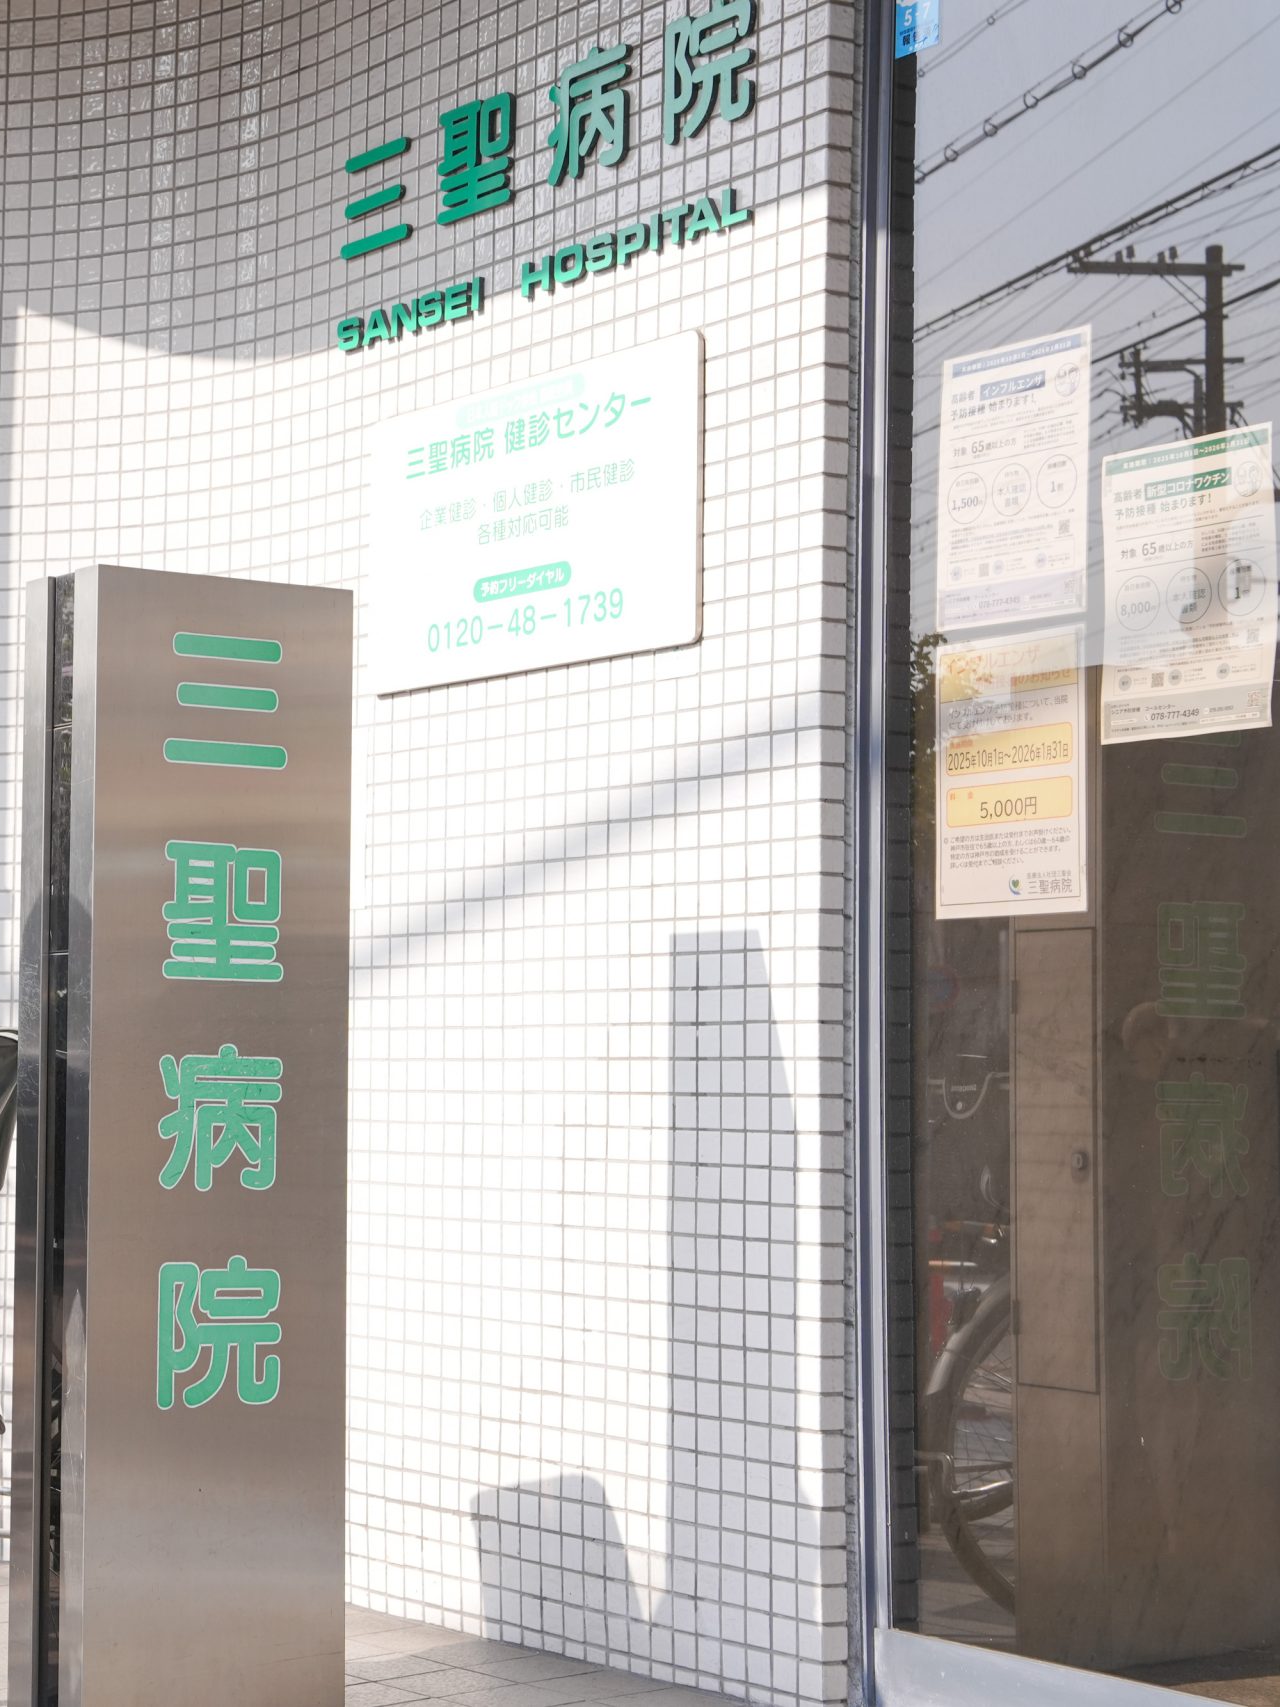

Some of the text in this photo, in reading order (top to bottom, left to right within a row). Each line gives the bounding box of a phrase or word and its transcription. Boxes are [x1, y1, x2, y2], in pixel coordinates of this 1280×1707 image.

[340, 0, 755, 260] 三聖病院
[336, 188, 750, 351] SANSEI HOSPITAL
[982, 374, 1042, 398] インフルエンザ
[405, 427, 495, 480] 三聖病院
[504, 391, 652, 454] 健診センター
[1114, 472, 1231, 504] 高齢者 新型コロナワクチン
[477, 505, 569, 546] 各種対応可能
[1114, 505, 1157, 521] 予防接種
[1120, 547, 1137, 559] 対象
[480, 567, 565, 600] 予約フリーダイヤル
[1150, 708, 1200, 721] 078-777-4349
[980, 796, 1037, 820] 5,000円
[1027, 878, 1073, 896] 三聖病院
[157, 631, 288, 1410] 三聖病院
